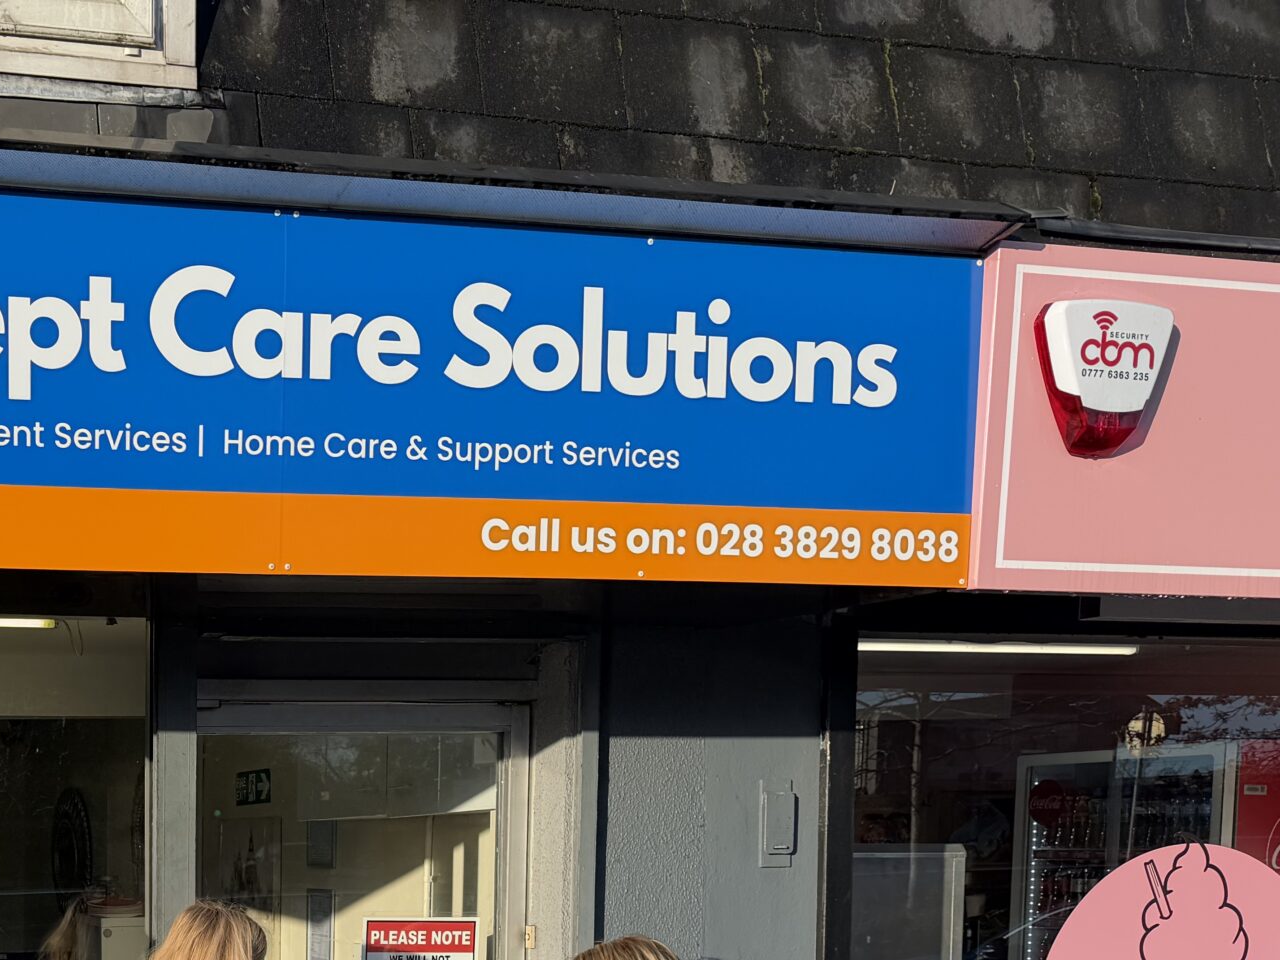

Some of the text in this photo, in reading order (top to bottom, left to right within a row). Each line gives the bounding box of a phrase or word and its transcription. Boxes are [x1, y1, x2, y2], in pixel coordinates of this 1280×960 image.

[150, 264, 421, 385] Care
[444, 282, 898, 408] Solutions
[1109, 331, 1150, 341] SECURITY
[1081, 368, 1149, 382] 0777 6363 235
[54, 422, 187, 453] Services
[224, 429, 315, 457] Home
[323, 432, 398, 460] Care
[406, 435, 428, 461] &
[437, 436, 554, 471] Support
[562, 440, 680, 469] Services
[481, 518, 959, 562] Call us on: 028 3829 8038
[370, 930, 471, 945] PLEASE NOTE
